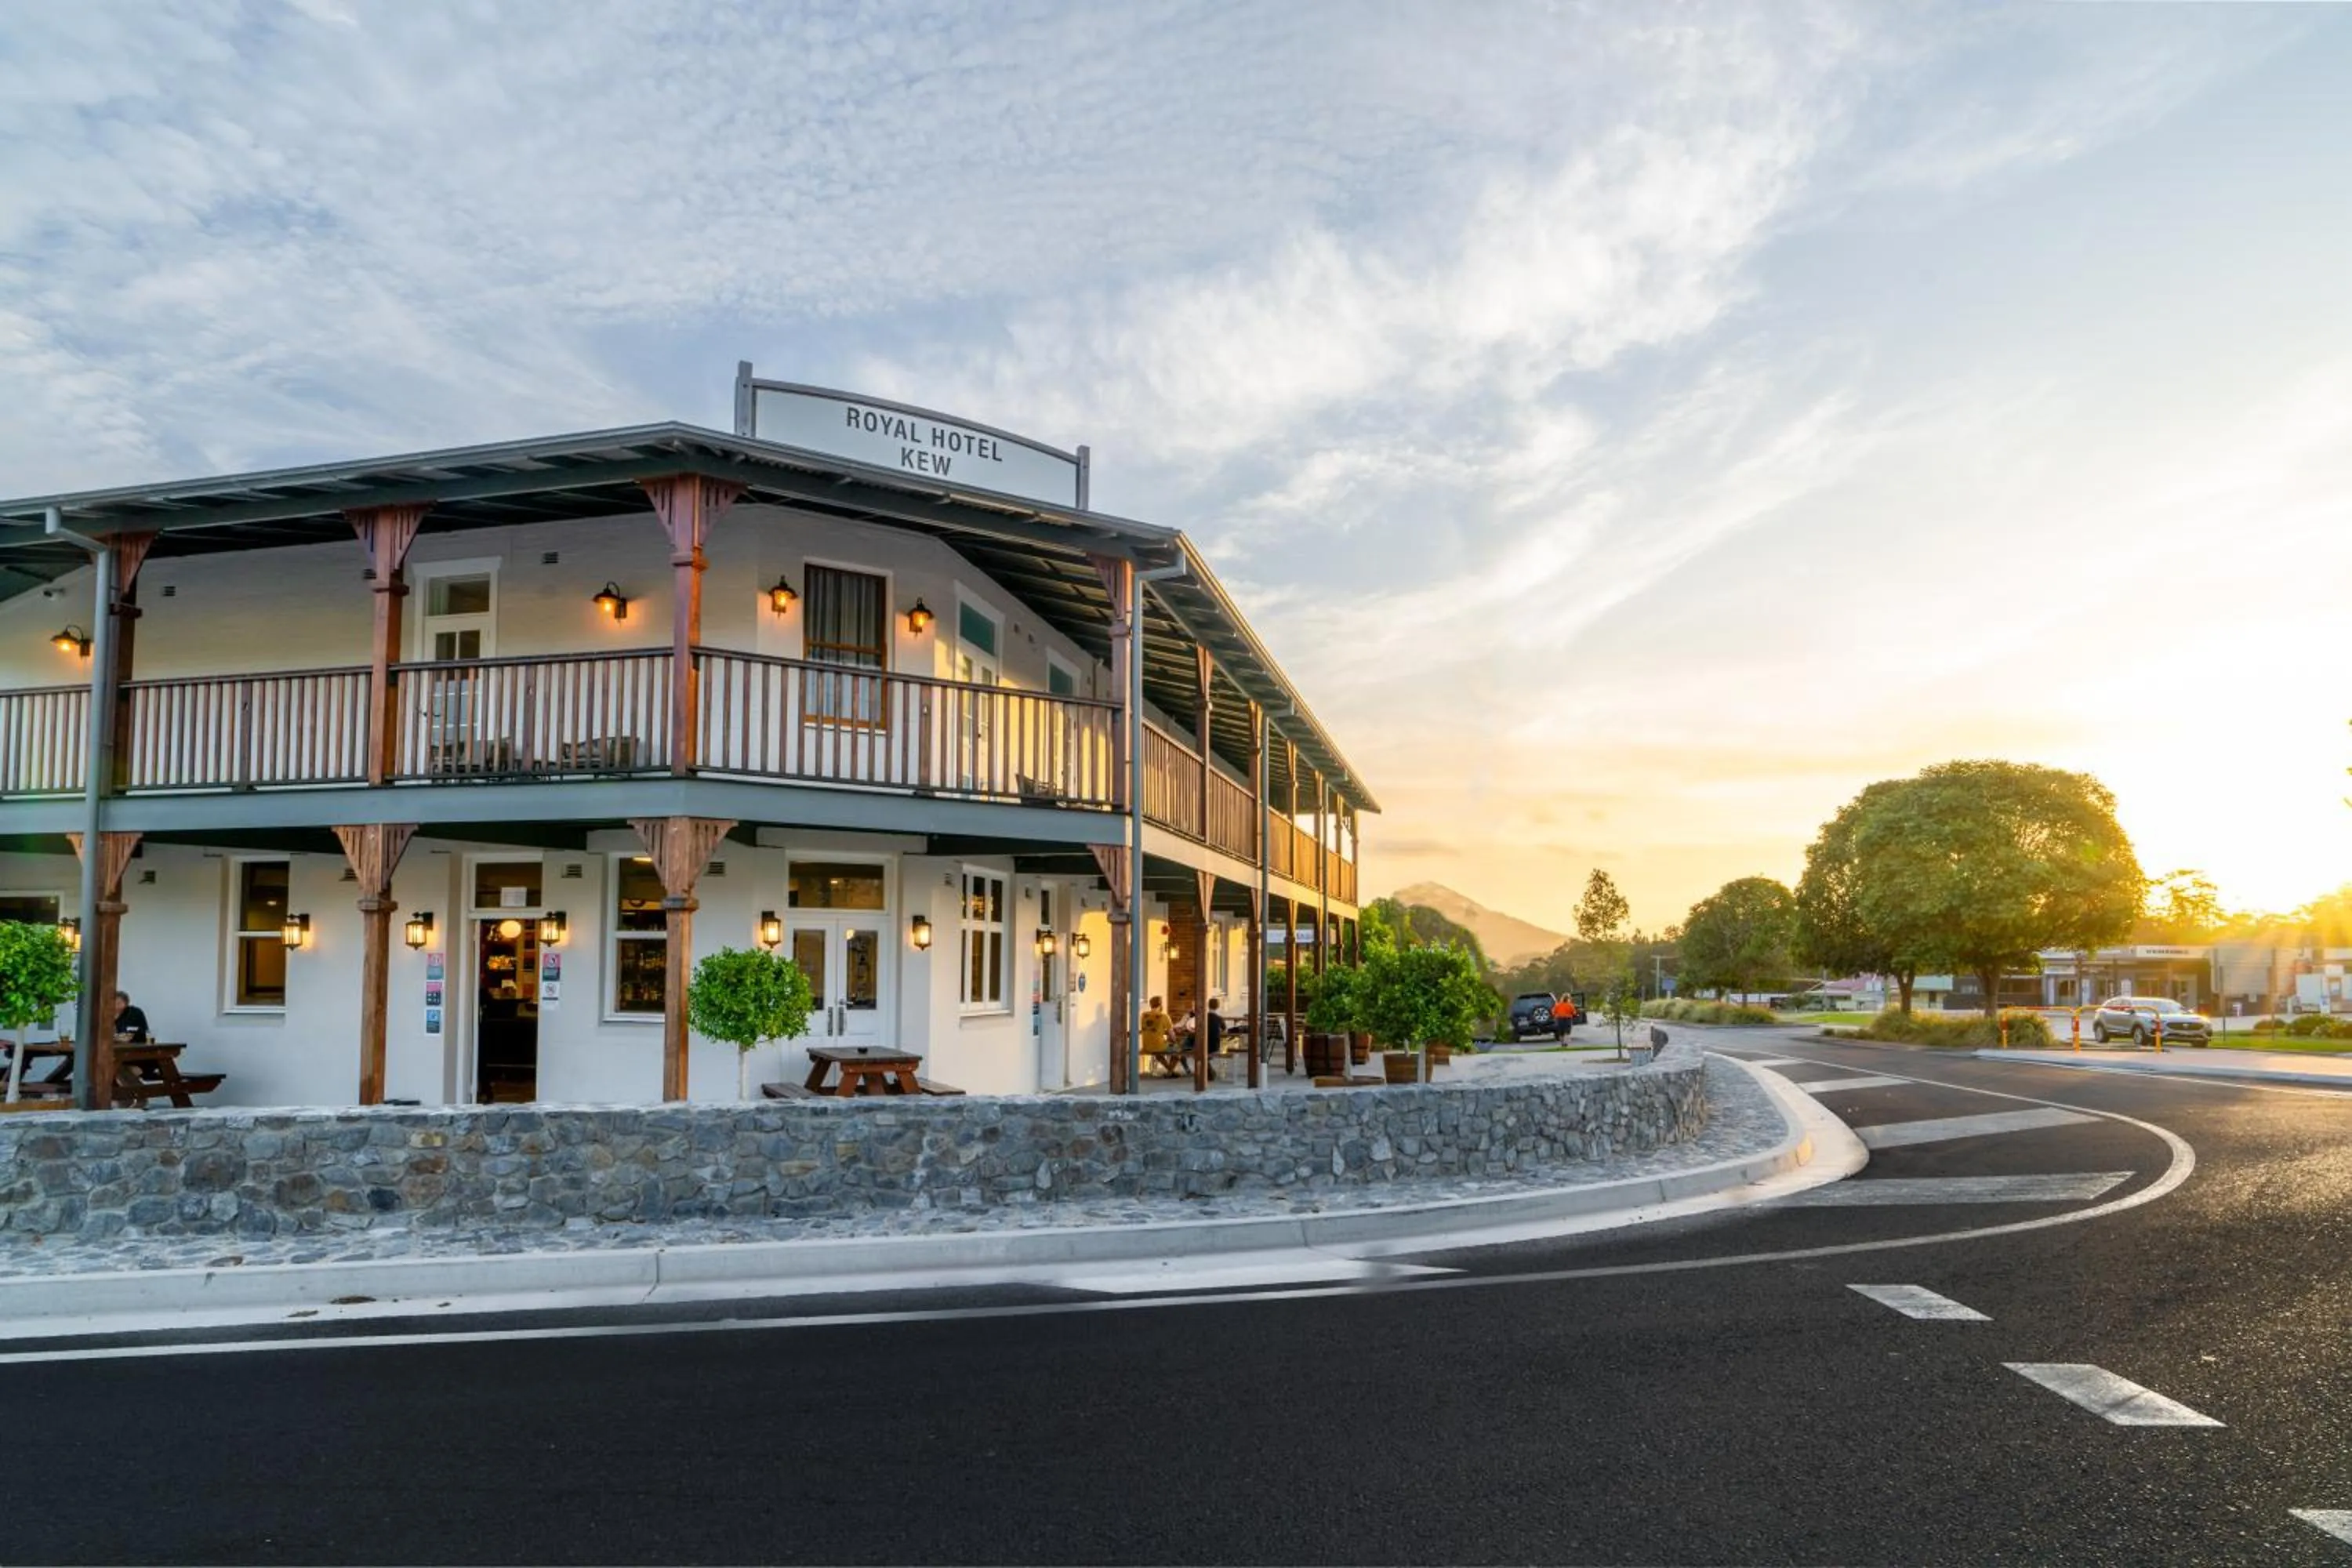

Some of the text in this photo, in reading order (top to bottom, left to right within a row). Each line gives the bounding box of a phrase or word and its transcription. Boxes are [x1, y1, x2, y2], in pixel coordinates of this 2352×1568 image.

[847, 406, 1003, 463] ROYAL HOTEL
[901, 447, 952, 476] KEW
